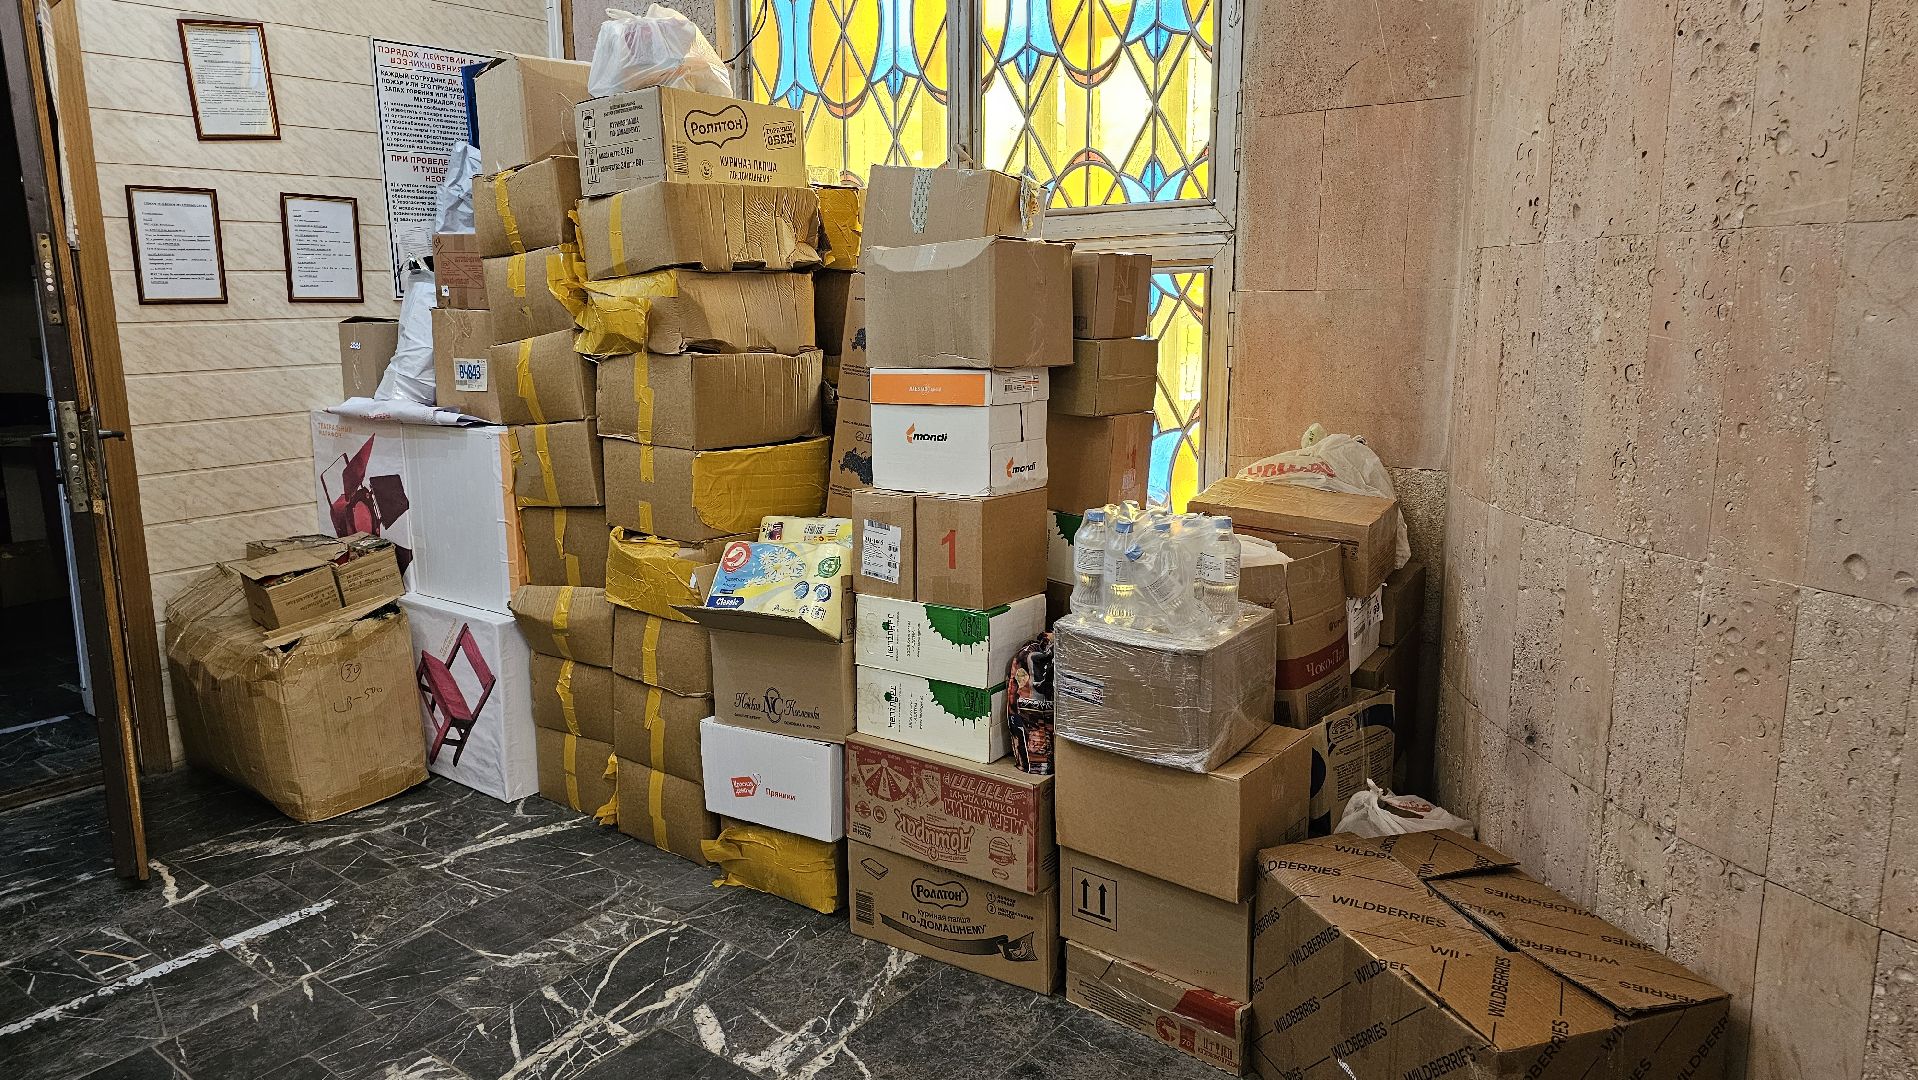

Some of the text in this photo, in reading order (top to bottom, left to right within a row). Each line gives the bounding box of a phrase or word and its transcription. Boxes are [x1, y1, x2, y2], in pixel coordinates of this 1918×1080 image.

[378, 45, 420, 59] ПОРЯДОК
[380, 69, 409, 80] КАЖДЫЙ
[411, 73, 446, 83] СОТРУДНИК
[381, 77, 404, 86] ПОЖАР
[420, 81, 432, 90] ЕГО
[384, 86, 405, 94] ЗАПАХ
[406, 88, 434, 97] ГОРЕНИЯ
[767, 132, 795, 146] ОБЕД
[391, 154, 450, 166] ПРИ ПРОВЕДЕ
[719, 155, 778, 172] КУРИНАЯ ЛАПША
[412, 165, 419, 173] И
[912, 432, 948, 442] mondi
[1012, 461, 1037, 474] mondi
[941, 529, 957, 570] 1
[715, 597, 740, 607] Classic
[765, 787, 796, 801] Пряники
[894, 808, 975, 855] Доширак
[917, 908, 971, 924] куриная лапша
[1332, 894, 1448, 929] WILDBERRIES
[901, 910, 984, 935] ПО-ДОМАШНЕМУ
[1288, 924, 1341, 967] WILDBERRIES
[1487, 955, 1511, 1018] WILDBERRIES
[1273, 996, 1321, 1034] WILDBERRIES
[1330, 1021, 1388, 1060] WILDBERRIES
